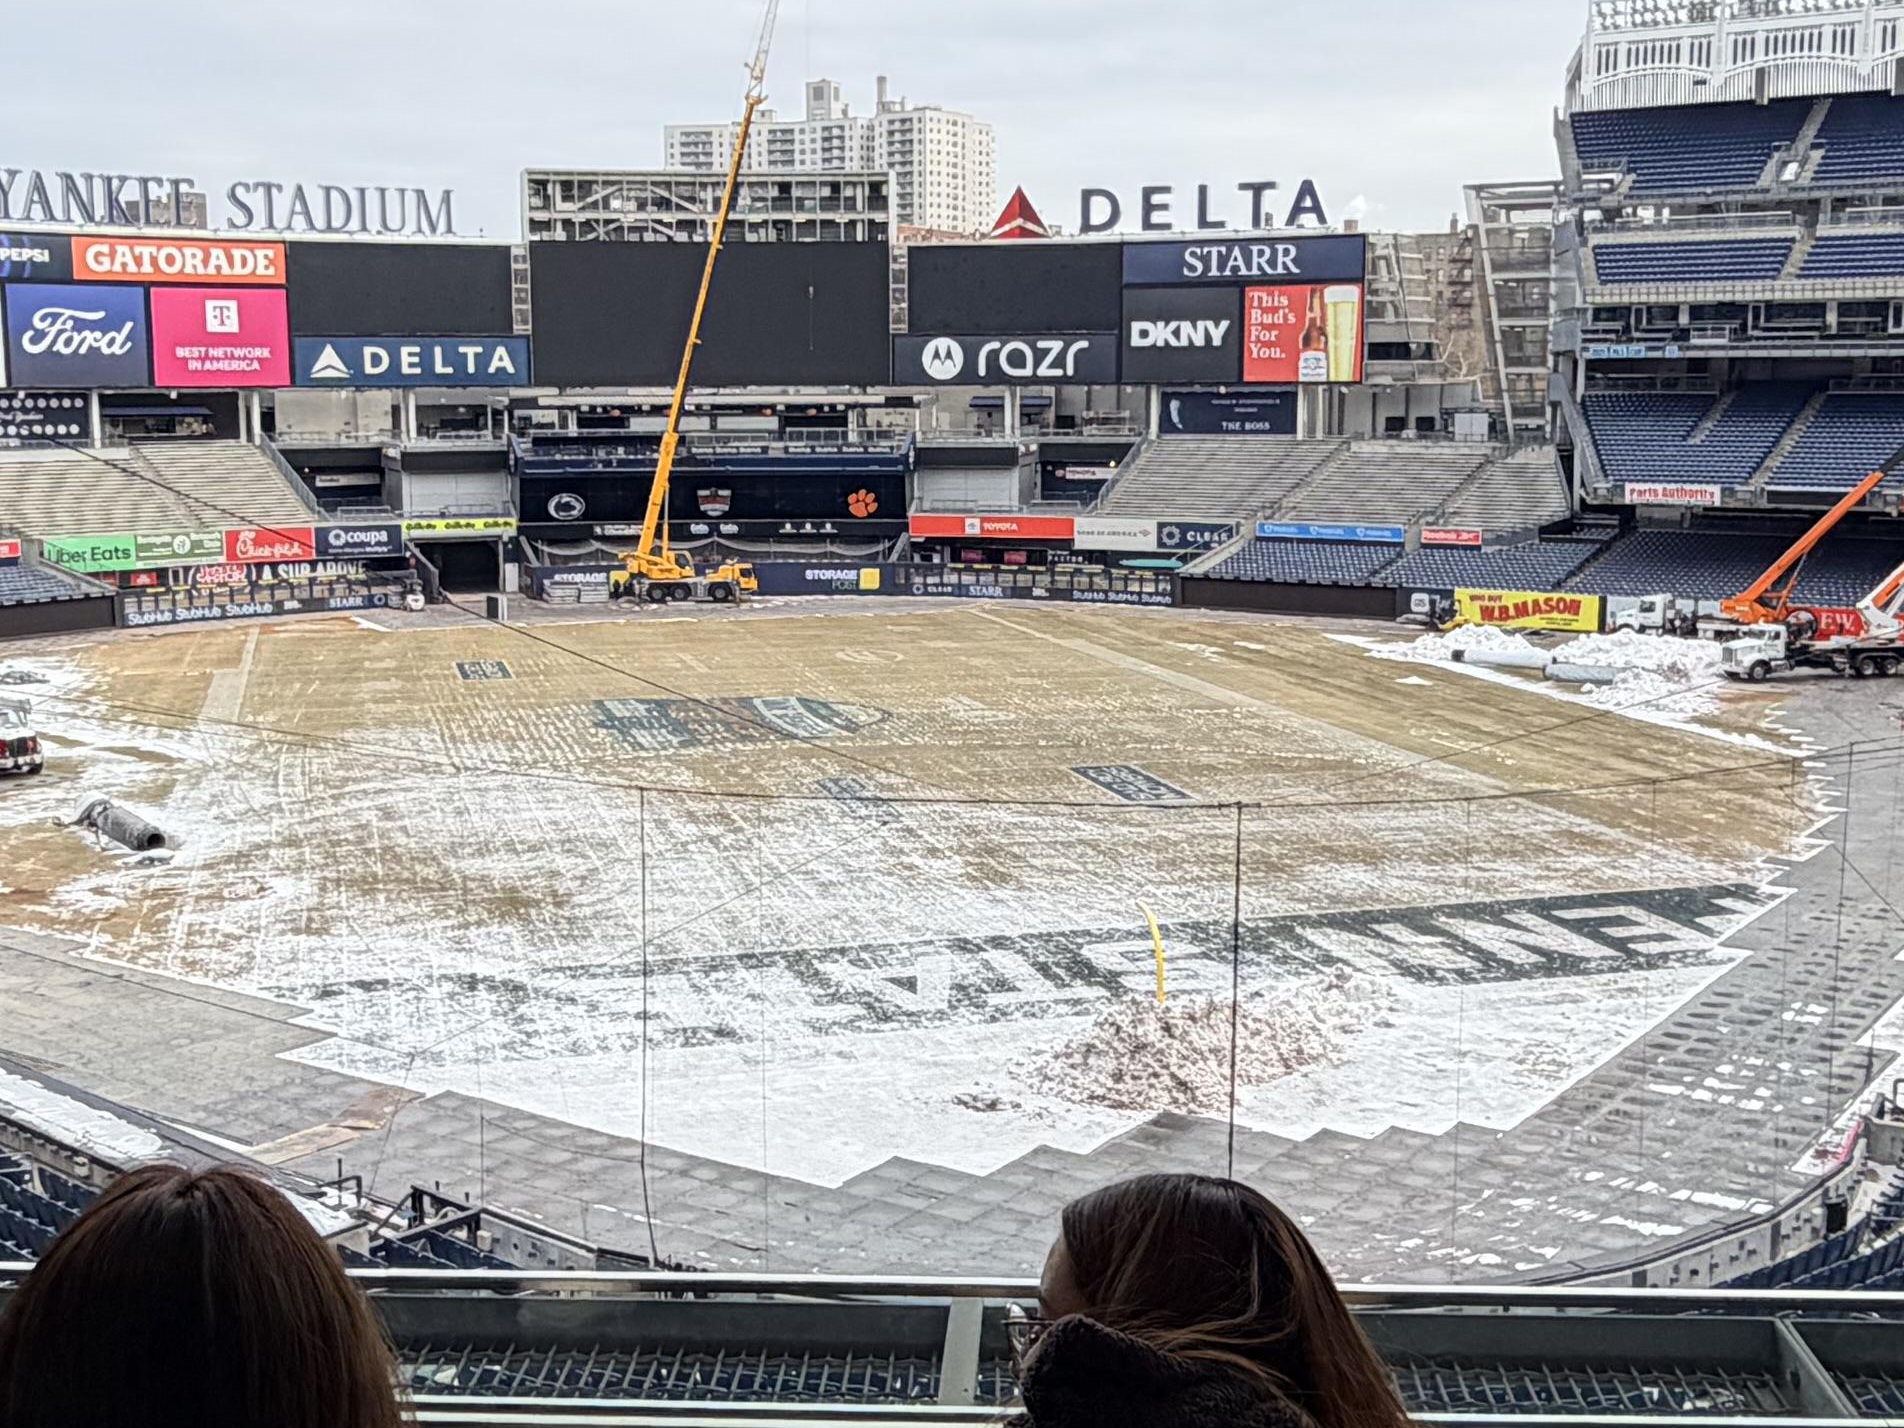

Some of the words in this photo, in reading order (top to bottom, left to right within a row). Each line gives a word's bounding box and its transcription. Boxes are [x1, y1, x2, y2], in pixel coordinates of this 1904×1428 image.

[227, 181, 457, 236] STADIUM
[1080, 178, 1329, 234] DELTA
[0, 247, 50, 263] PEPSI
[85, 243, 278, 276] GATORADE
[1183, 244, 1301, 277] STARR
[1249, 291, 1290, 307] This
[1249, 309, 1297, 325] Bud's
[21, 307, 135, 356] Ford
[1130, 319, 1231, 348] DKNY
[1249, 326, 1279, 343] For
[175, 347, 206, 359] BEST
[208, 347, 271, 360] NETWORK
[978, 339, 1090, 378] razr
[1249, 342, 1287, 360] You.
[187, 359, 202, 372] IN
[203, 359, 261, 372] AMERICA
[362, 345, 516, 375] DELTA
[1630, 487, 1659, 500] Parts
[1661, 486, 1715, 500] Authority
[983, 521, 1018, 532] TOYOTA
[347, 529, 388, 546] coupa
[1187, 530, 1230, 542] CLEAR
[48, 548, 87, 565] Uber
[89, 545, 132, 562] Eats
[805, 569, 858, 581] STORAGE
[968, 585, 1004, 597] STARR
[329, 595, 365, 608] STARR
[127, 608, 173, 626] StubHub
[175, 604, 222, 621] StubHub
[225, 600, 273, 617] StubHub
